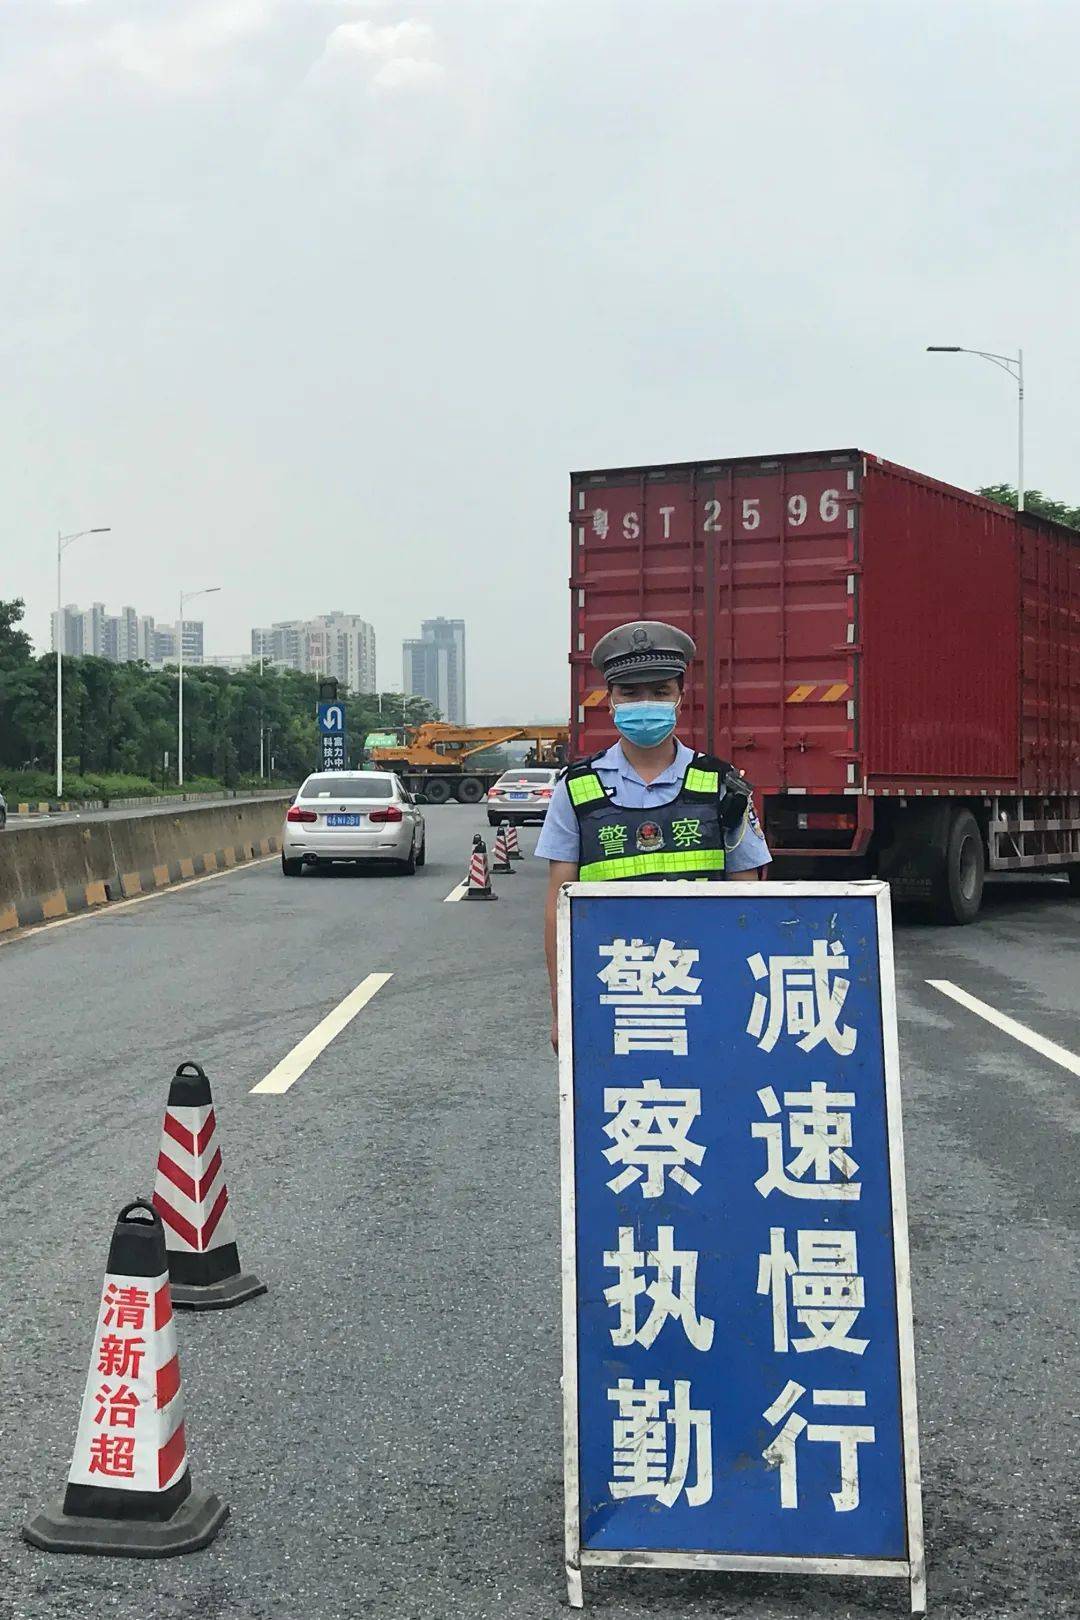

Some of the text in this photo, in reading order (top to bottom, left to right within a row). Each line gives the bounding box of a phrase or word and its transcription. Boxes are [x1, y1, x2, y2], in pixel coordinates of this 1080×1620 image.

[88, 1283, 151, 1479] 清新治超
[597, 938, 716, 1509] 警察执勤
[746, 938, 877, 1514] 减速慢行
